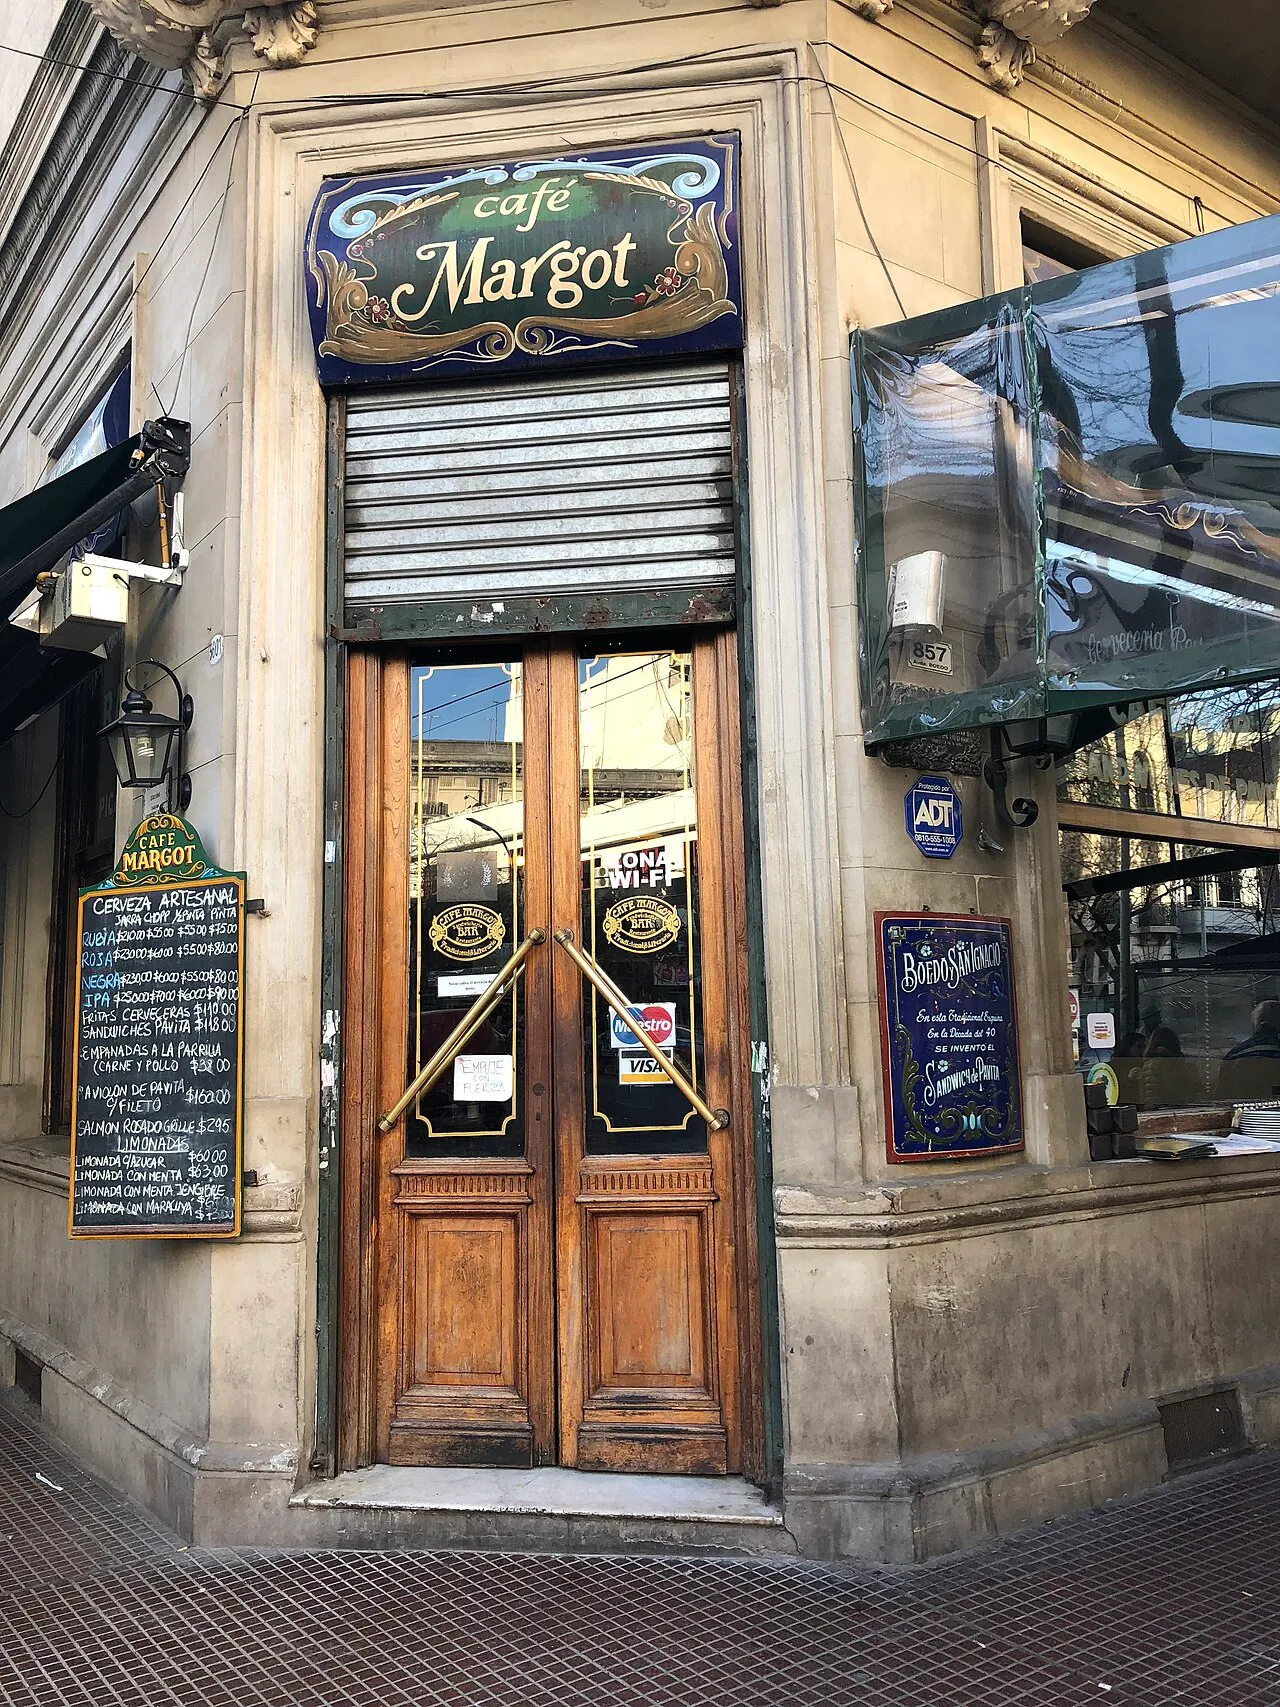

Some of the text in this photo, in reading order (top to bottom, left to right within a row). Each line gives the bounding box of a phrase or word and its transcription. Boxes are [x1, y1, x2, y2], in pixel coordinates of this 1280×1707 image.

[473, 177, 578, 233] café
[391, 233, 637, 322] Margot
[913, 641, 947, 662] 857
[929, 662, 949, 671] BOEDO
[918, 782, 941, 792] Protegido
[915, 798, 953, 828] ADT
[122, 845, 196, 872] MARGOT
[609, 851, 666, 869] ONA
[608, 869, 672, 889] WI-FI
[93, 887, 238, 915] CERVEZA ARTESANAL
[612, 899, 673, 918] CAFE MARGOT
[115, 913, 142, 927] JARRA
[143, 909, 171, 924] CHOPP
[439, 907, 499, 926] CAFE MARGOT
[631, 918, 653, 929] BAR
[457, 926, 479, 937] BAR
[82, 951, 113, 969] ROJA
[82, 972, 121, 991] NEGRA
[83, 992, 111, 1008] IPA
[122, 1006, 191, 1022] CERVECERAS
[916, 1008, 931, 1023] En
[931, 1012, 947, 1022] esta
[82, 1022, 152, 1039] SANDWICHES
[927, 1027, 939, 1039] En
[940, 1027, 949, 1038] la
[974, 1028, 984, 1038] del
[985, 1027, 996, 1037] 40
[82, 1043, 149, 1061] EMPANADAS
[151, 1043, 158, 1058] A
[161, 1042, 174, 1057] LA
[935, 1045, 948, 1053] SE
[137, 1059, 143, 1072] Y
[145, 1059, 179, 1072] POLLO
[462, 1059, 504, 1075] EMPUJE
[629, 1060, 663, 1073] VISA
[970, 1067, 979, 1084] de
[131, 1083, 147, 1097] DE
[150, 1079, 185, 1096] PAVITA
[463, 1082, 506, 1094] FUERZA
[77, 1119, 120, 1137] SALMON
[122, 1117, 163, 1134] ROSADO
[195, 1115, 231, 1136] $295
[117, 1135, 190, 1152] LIMONADAS
[126, 1171, 147, 1182] CON
[149, 1169, 183, 1182] MENTA
[74, 1184, 122, 1198] LIMONADA
[123, 1184, 142, 1198] CON
[126, 1201, 143, 1216] CON
